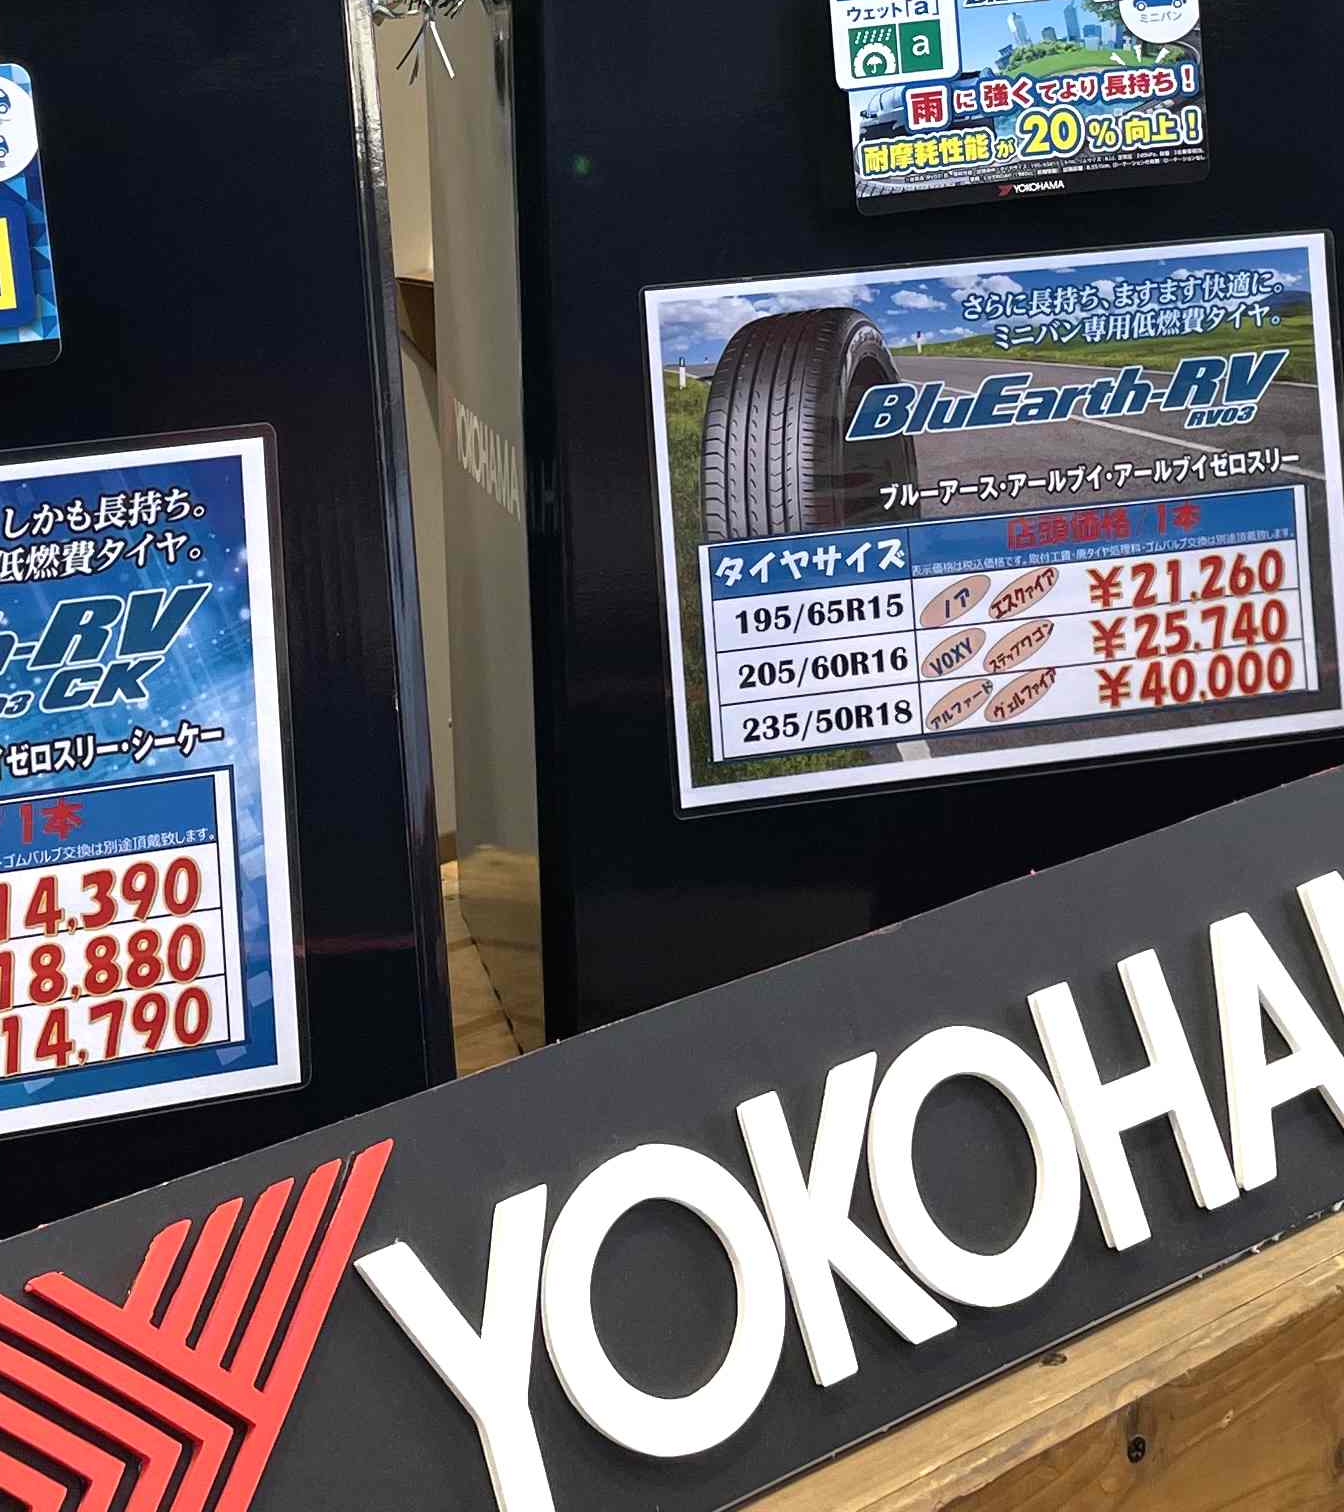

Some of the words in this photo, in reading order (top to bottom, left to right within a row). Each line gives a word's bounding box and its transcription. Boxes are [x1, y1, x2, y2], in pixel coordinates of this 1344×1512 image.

[1138, 10, 1183, 24] ミニバン
[911, 35, 931, 58] a
[1012, 179, 1066, 195] YOKOHAMA
[960, 269, 1284, 321] さらに長持ち、ますます快適に。
[992, 302, 1283, 351] ミニバン専用低燃費タイヤ。
[846, 349, 1290, 443] BluEarth-RV
[1184, 404, 1258, 429] RV03
[713, 539, 909, 587] タイヤサイズ
[734, 592, 905, 637] 195/65R15
[990, 566, 1056, 620] エスクァイア
[38, 657, 157, 717] CK
[738, 645, 910, 691] 205/60R16
[929, 636, 976, 677] VOXY
[741, 697, 914, 744] 235/50R18
